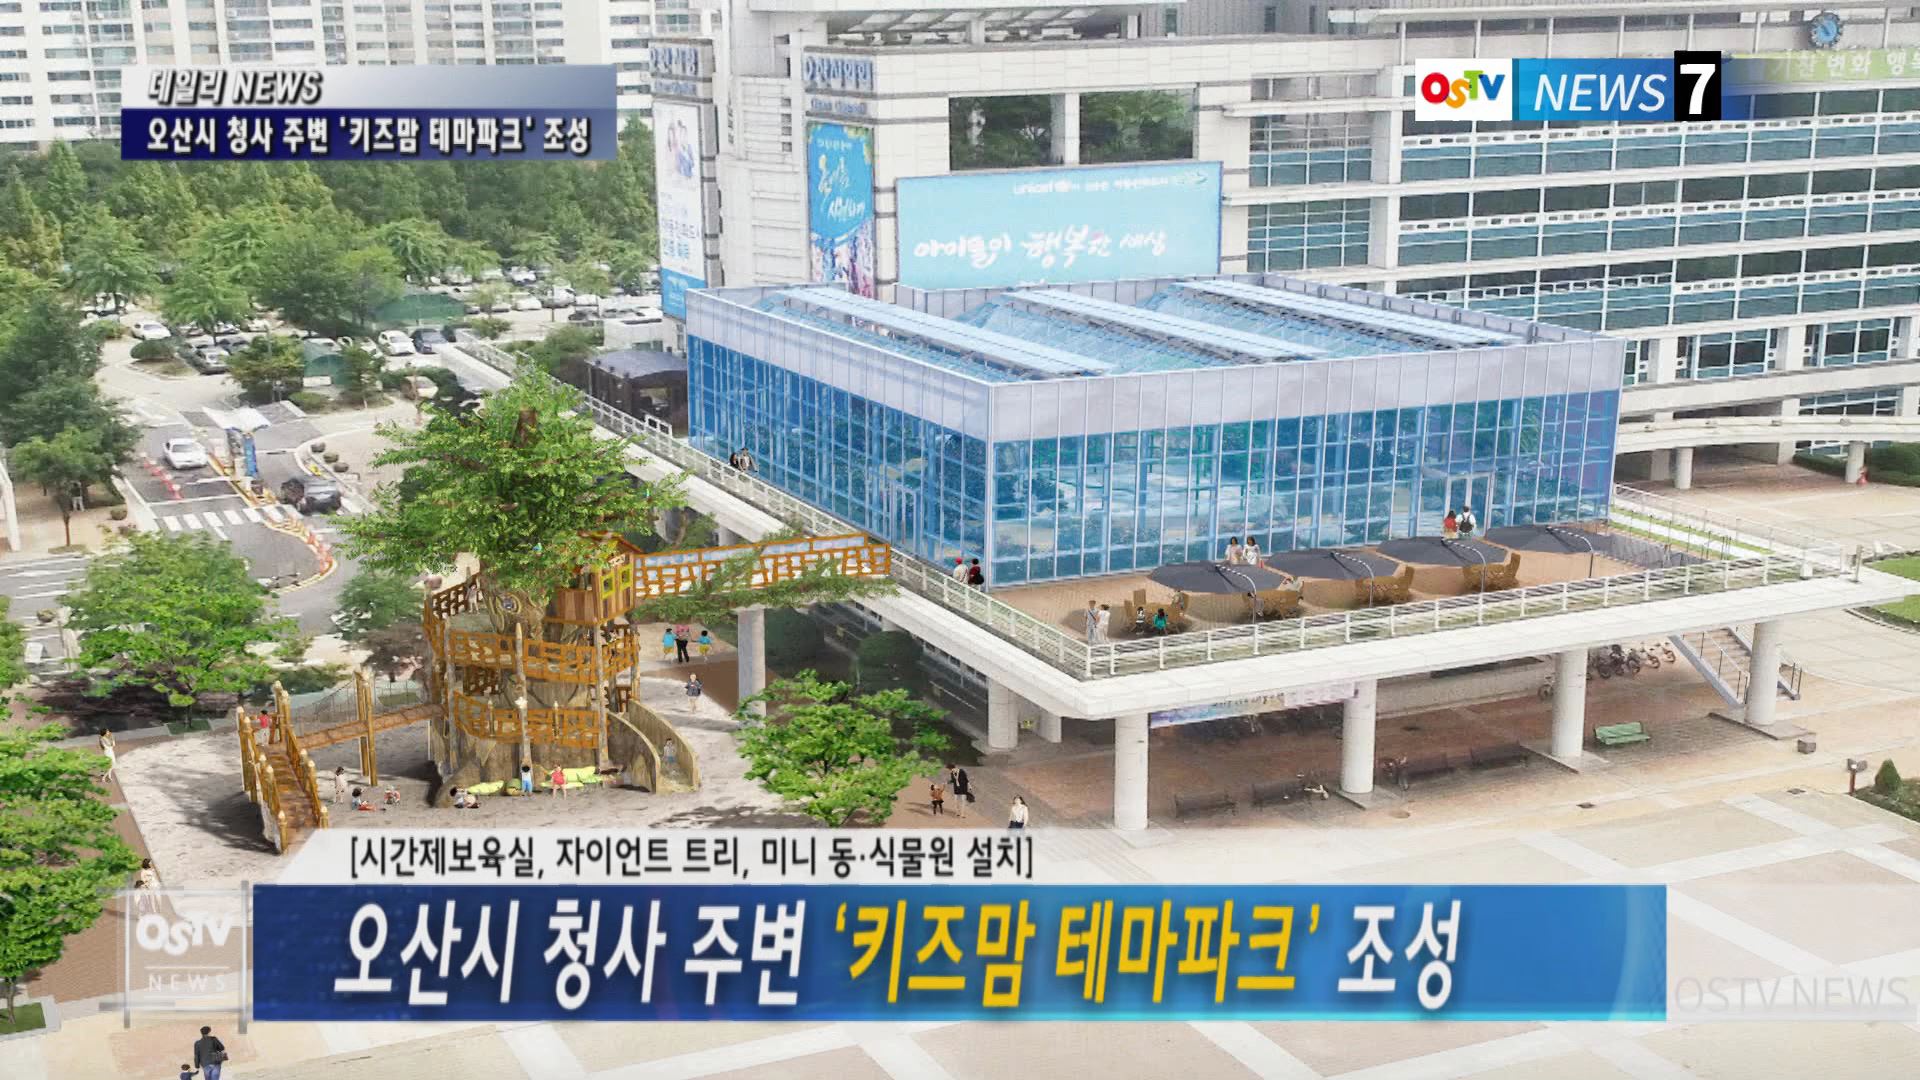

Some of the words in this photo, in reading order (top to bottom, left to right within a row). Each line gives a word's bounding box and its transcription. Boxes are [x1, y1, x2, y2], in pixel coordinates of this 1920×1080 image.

[912, 233, 1013, 269] 아이들이
[1020, 224, 1113, 269] 행복한
[1119, 230, 1167, 257] 세상
